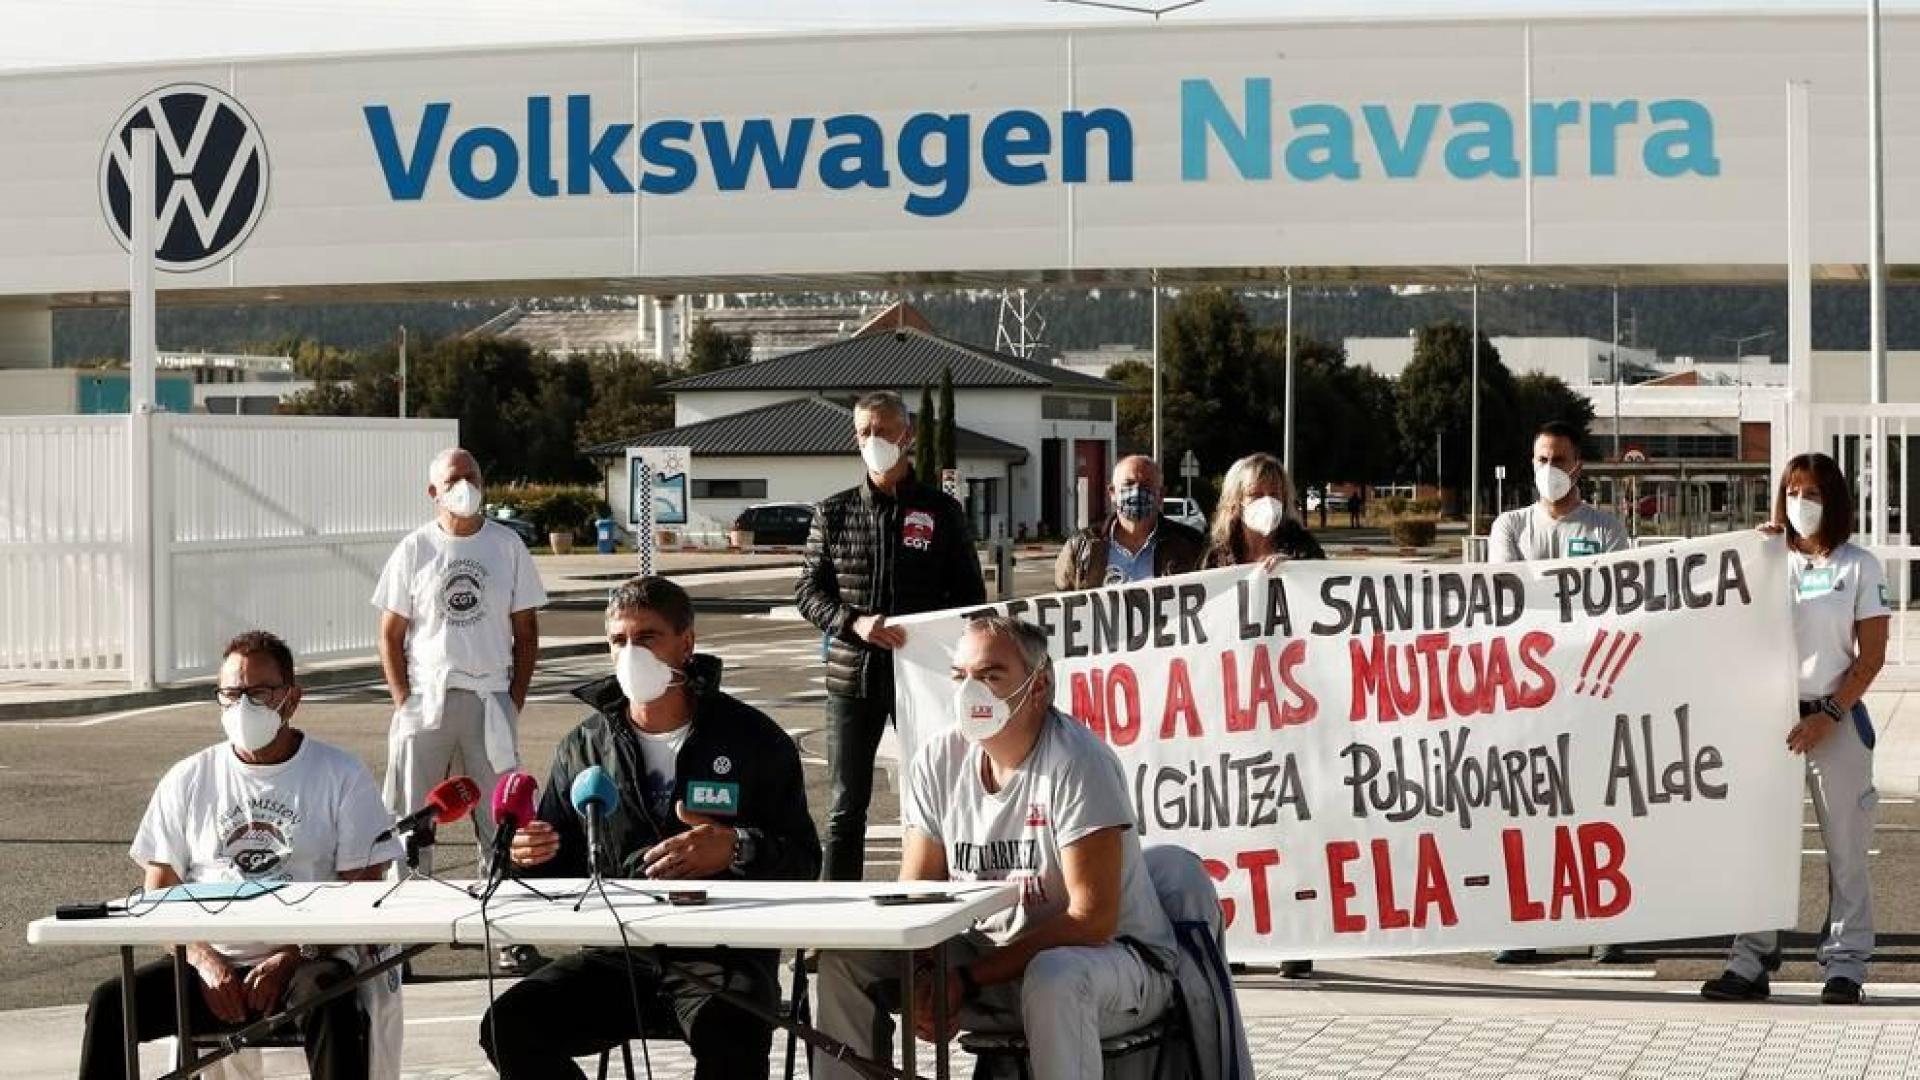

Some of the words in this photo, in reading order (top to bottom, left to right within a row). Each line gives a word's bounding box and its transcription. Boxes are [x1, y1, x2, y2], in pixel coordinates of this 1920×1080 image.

[363, 94, 1134, 218] Volkswagen
[1180, 77, 1721, 183] Navarra
[904, 536, 932, 551] CGT
[961, 583, 1208, 658] FENDER
[1237, 577, 1293, 640] LA
[1071, 662, 1141, 747] NO
[1159, 656, 1204, 739] A
[1221, 639, 1319, 733] LAS
[1348, 630, 1556, 723] MUTUAS
[693, 786, 732, 804] ELA
